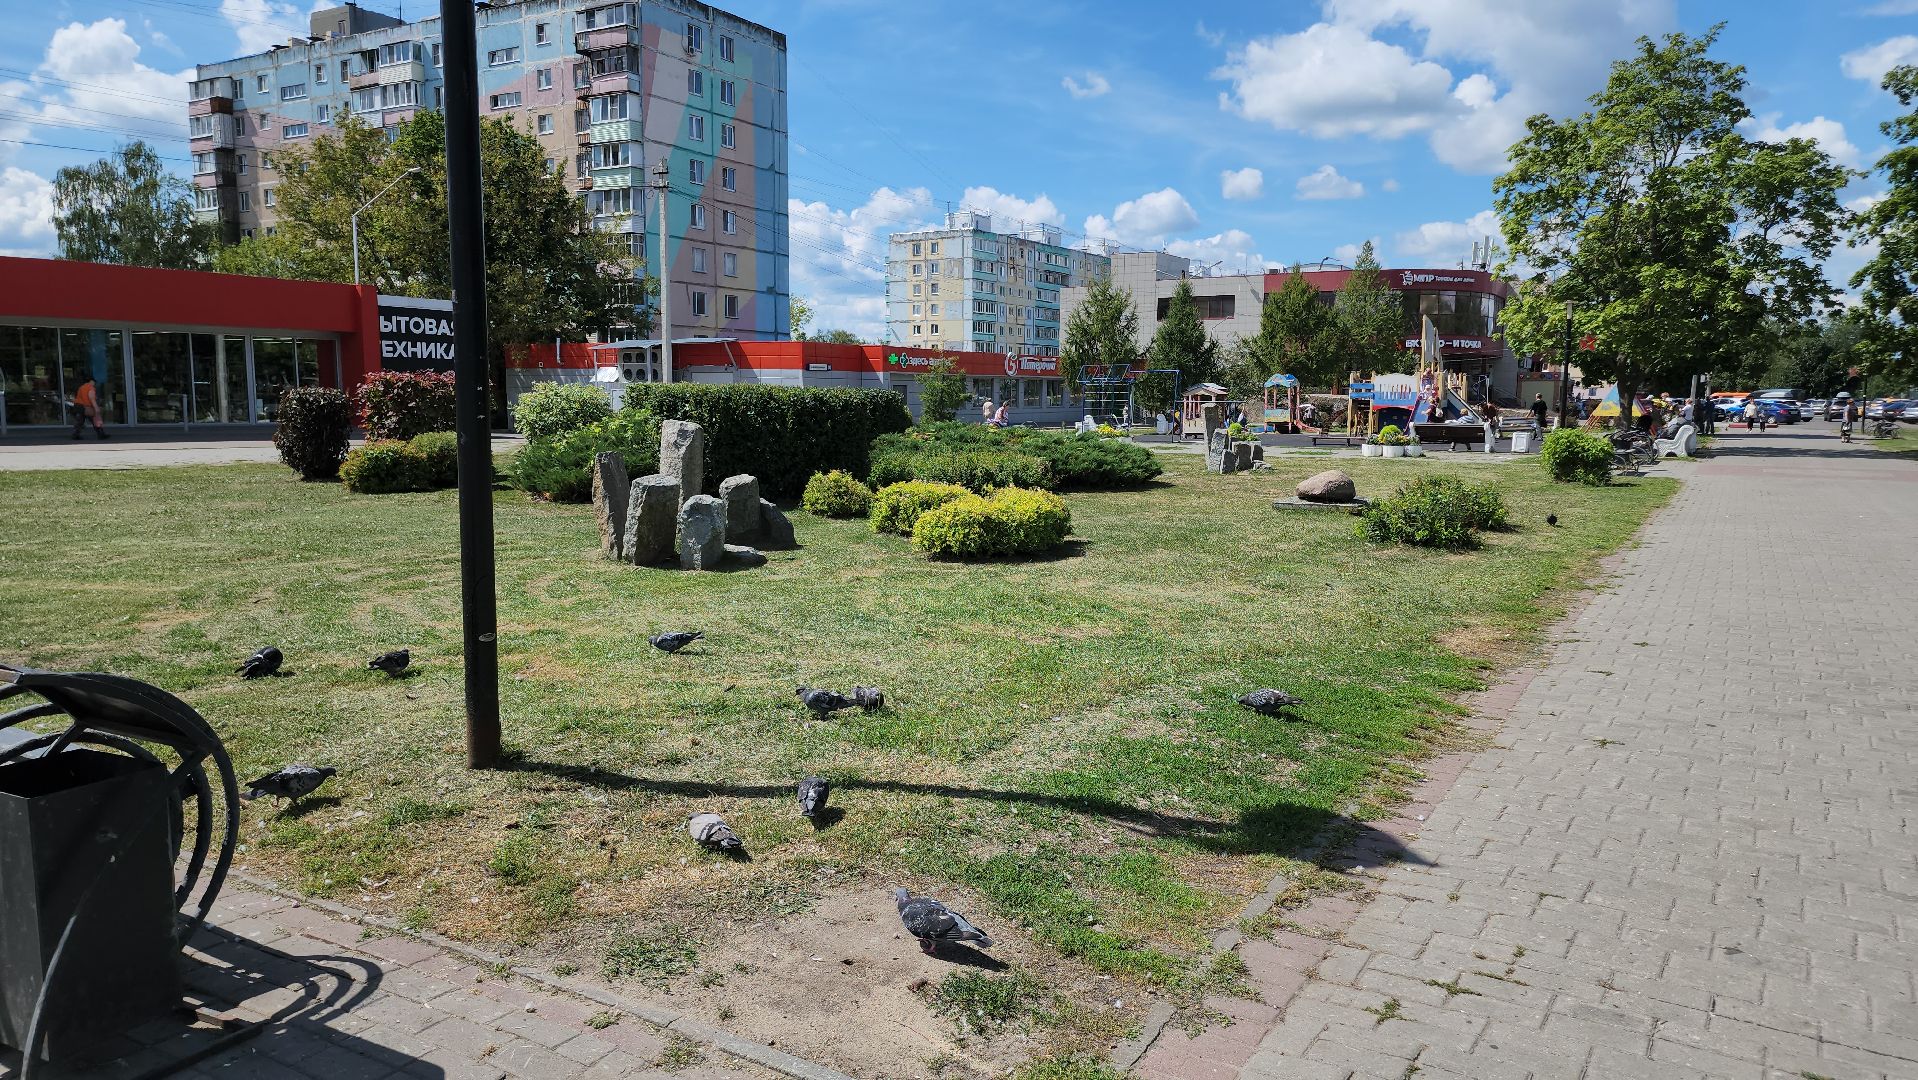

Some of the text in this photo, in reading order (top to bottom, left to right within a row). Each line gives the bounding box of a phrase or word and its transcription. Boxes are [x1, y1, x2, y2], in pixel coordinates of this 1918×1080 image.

[379, 315, 454, 336] ЫТОВА
[1453, 340, 1460, 348] И
[1461, 340, 1481, 349] ТОЧКА
